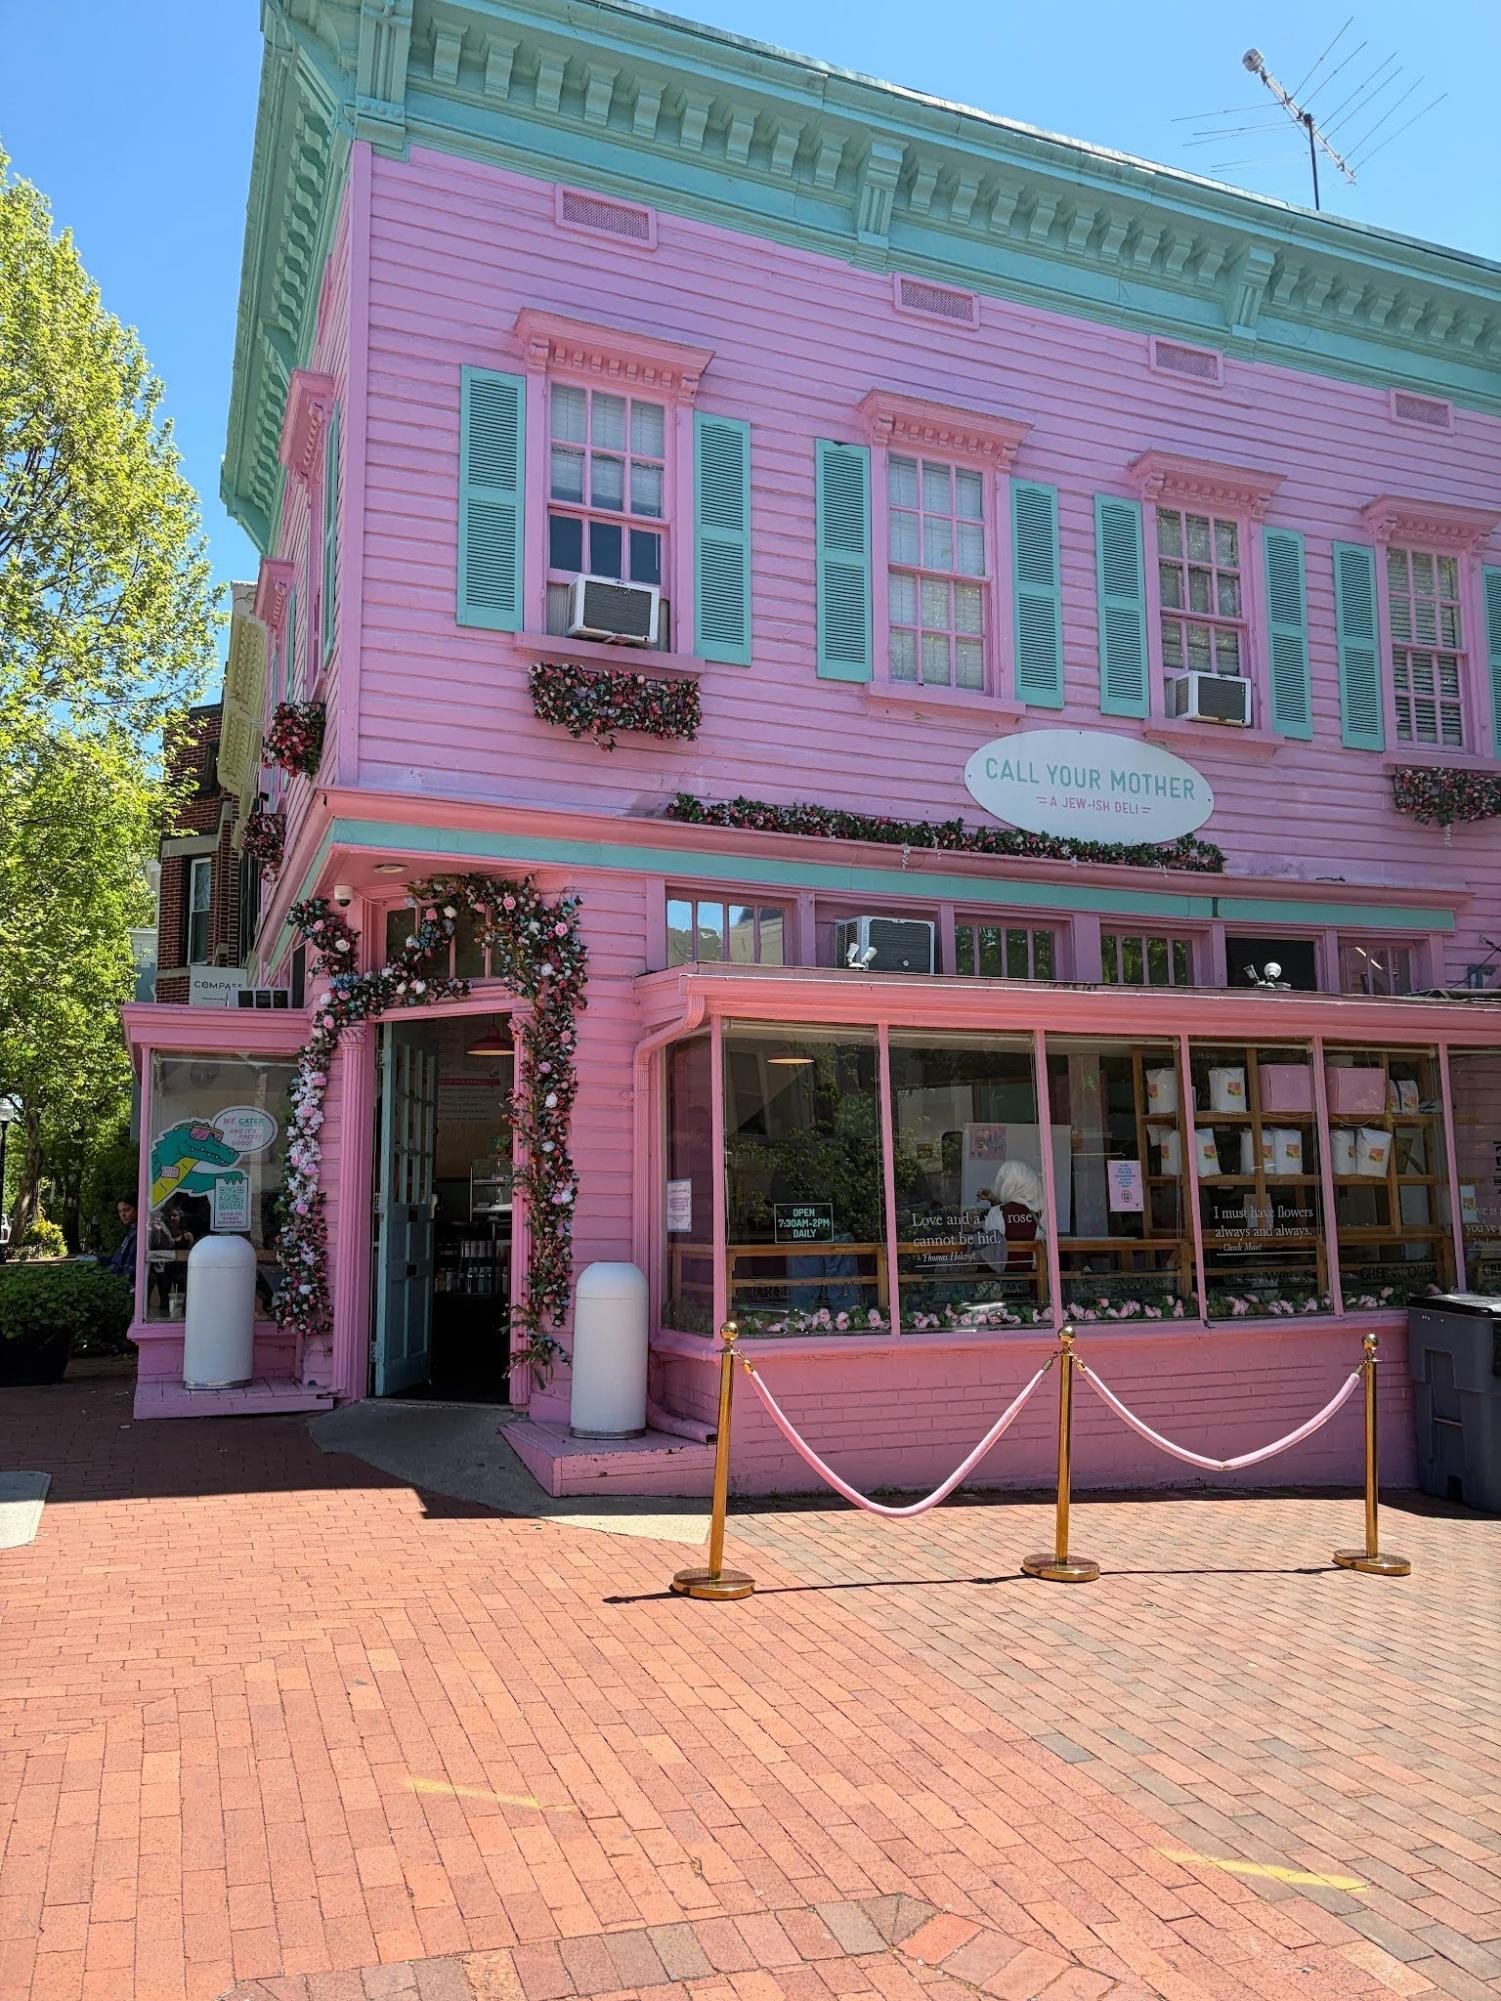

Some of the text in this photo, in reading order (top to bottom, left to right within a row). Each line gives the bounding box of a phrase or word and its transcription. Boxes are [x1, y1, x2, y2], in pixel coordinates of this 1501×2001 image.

[985, 757, 1195, 800] CALL YOUR MOTHER
[1049, 796, 1139, 814] A JEW-ISH DELI
[792, 1208, 816, 1217] OPEN
[911, 1213, 942, 1227] Love
[946, 1212, 970, 1225] and
[973, 1216, 981, 1224] a
[1007, 1212, 1033, 1224] rose
[1213, 1206, 1219, 1219] I
[1221, 1208, 1247, 1219] must
[1277, 1205, 1314, 1219] flowers
[778, 1218, 830, 1228] 7:30AM-2PM
[792, 1229, 817, 1238] DAILY
[913, 1230, 1001, 1247] cannot be hid.
[1215, 1223, 1313, 1240] always and always.
